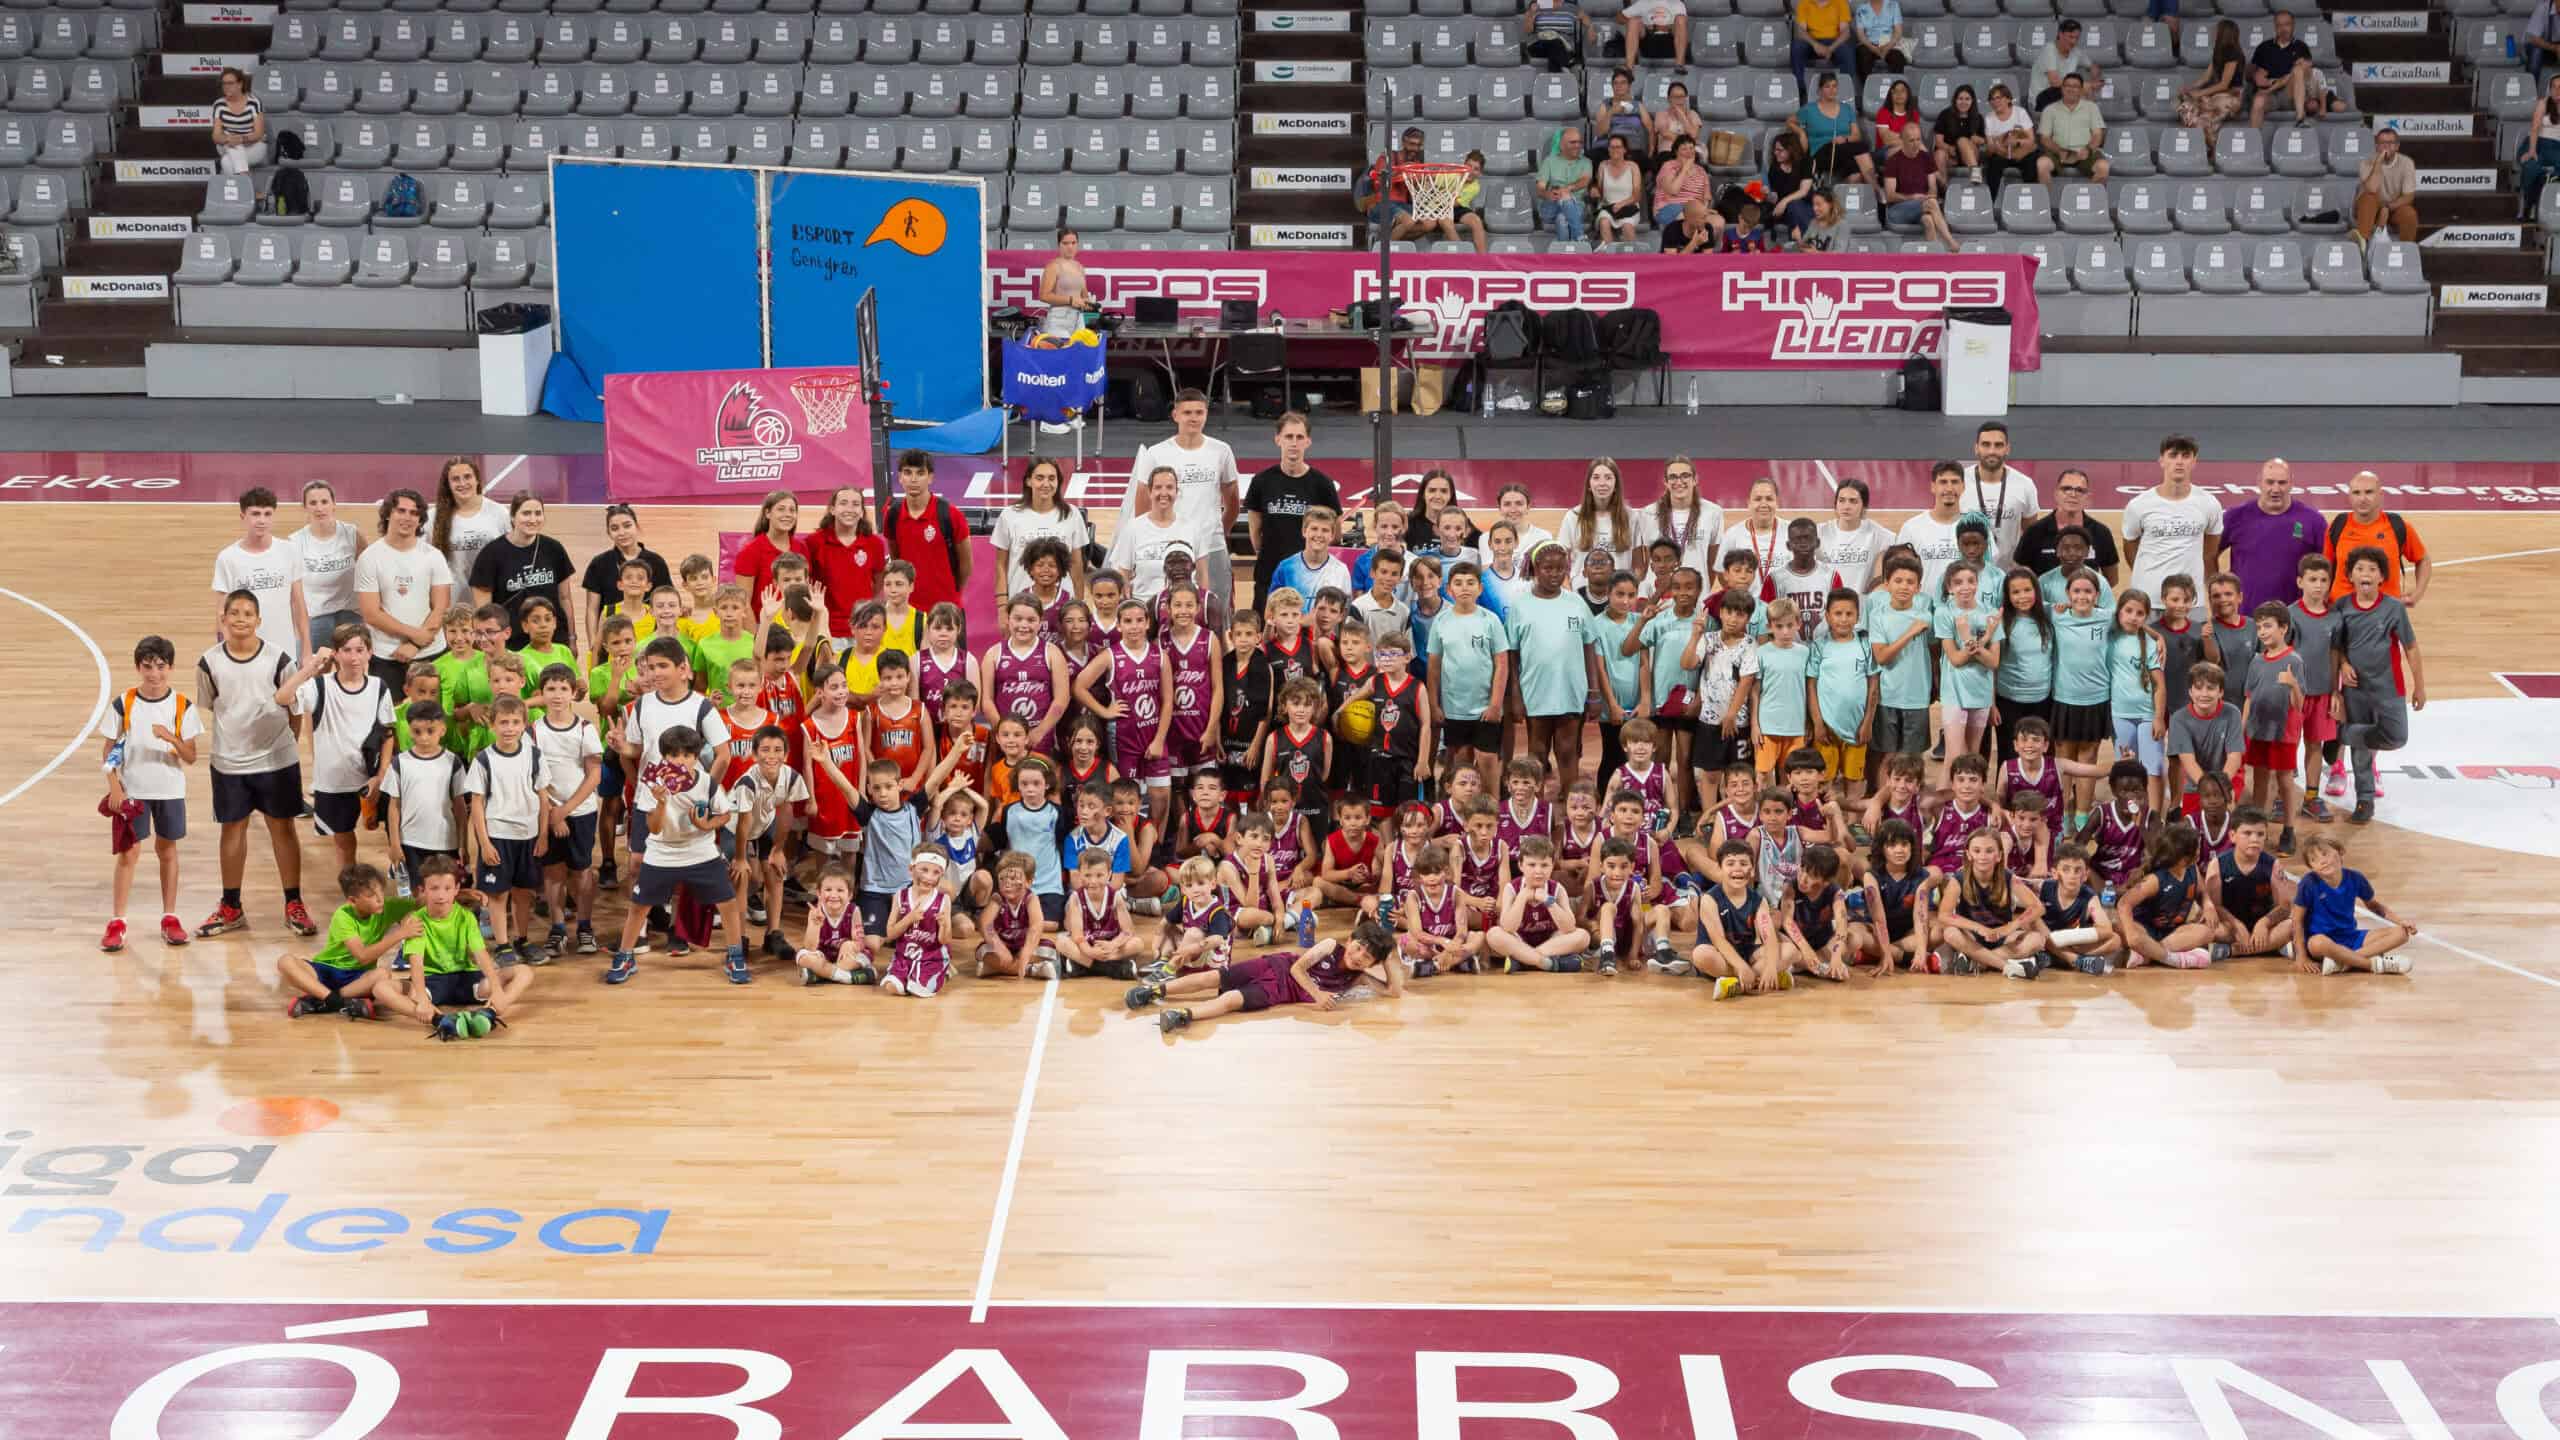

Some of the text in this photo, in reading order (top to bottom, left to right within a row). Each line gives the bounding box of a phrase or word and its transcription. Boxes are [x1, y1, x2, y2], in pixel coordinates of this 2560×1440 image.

[2360, 15, 2419, 28] CaixaBank
[2381, 66, 2440, 79] CaixaBank
[1278, 119, 1347, 128] McDonald's
[2402, 118, 2464, 132] CaixaBank
[141, 166, 211, 176] McDonald's
[1277, 173, 1346, 183] McDonald's
[2420, 175, 2491, 185] McDonald's
[116, 222, 187, 233] McDonald's
[1276, 230, 1348, 240] McDonald's
[2443, 231, 2515, 242] McDonald's
[90, 281, 163, 291] McDonald's
[988, 270, 1264, 306] HPOS
[1723, 272, 2004, 308] HIOPOS
[2467, 290, 2542, 301] McDonald's
[1773, 321, 1943, 357] LLEIDA
[1017, 371, 1067, 387] molten
[716, 463, 784, 482] LLEIDA
[8, 1193, 672, 1254] ndesa
